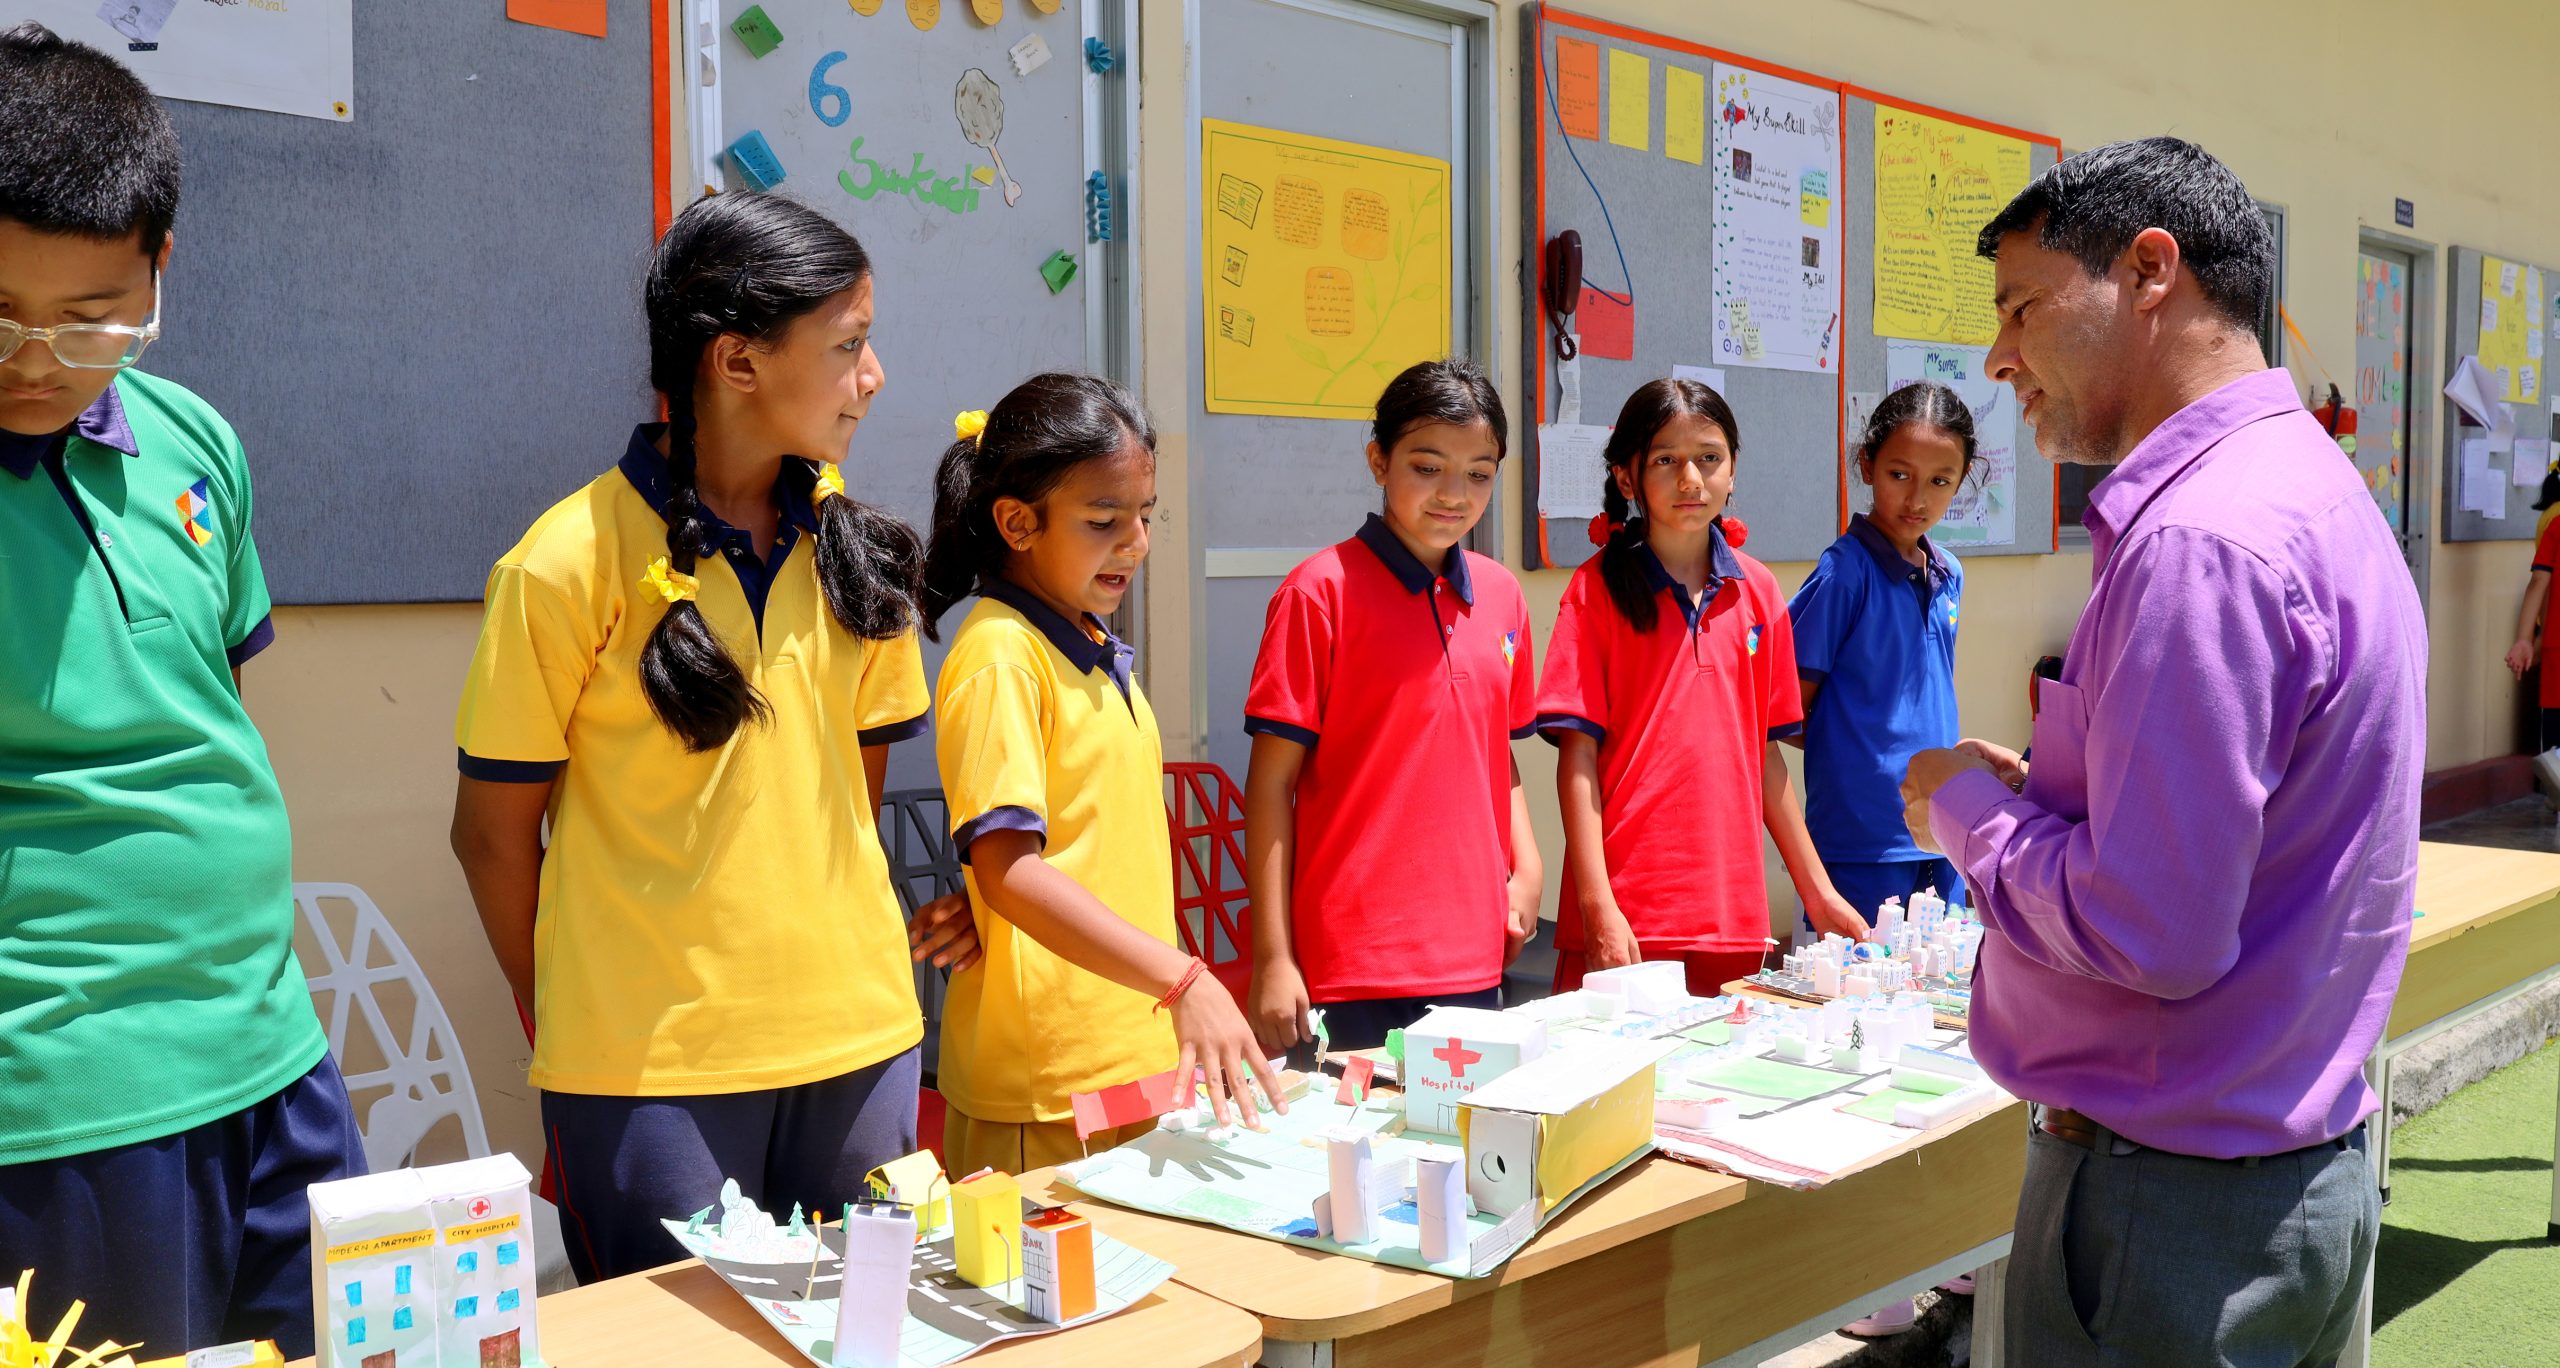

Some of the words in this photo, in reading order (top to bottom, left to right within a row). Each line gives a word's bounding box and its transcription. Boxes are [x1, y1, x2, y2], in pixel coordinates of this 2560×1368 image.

[808, 50, 852, 128] 6
[1747, 101, 1761, 132] My
[1923, 127, 1936, 154] My
[1939, 148, 1954, 166] Arts
[1802, 272, 1814, 290] My
[1926, 352, 1940, 364] MY
[1938, 359, 1958, 372] SUPER
[1421, 1076, 1475, 1093] Hospital
[452, 1229, 471, 1238] CITY
[476, 1220, 517, 1234] HOSPITAL
[328, 1244, 369, 1256] MODERN
[373, 1234, 434, 1250] APARTMENT
